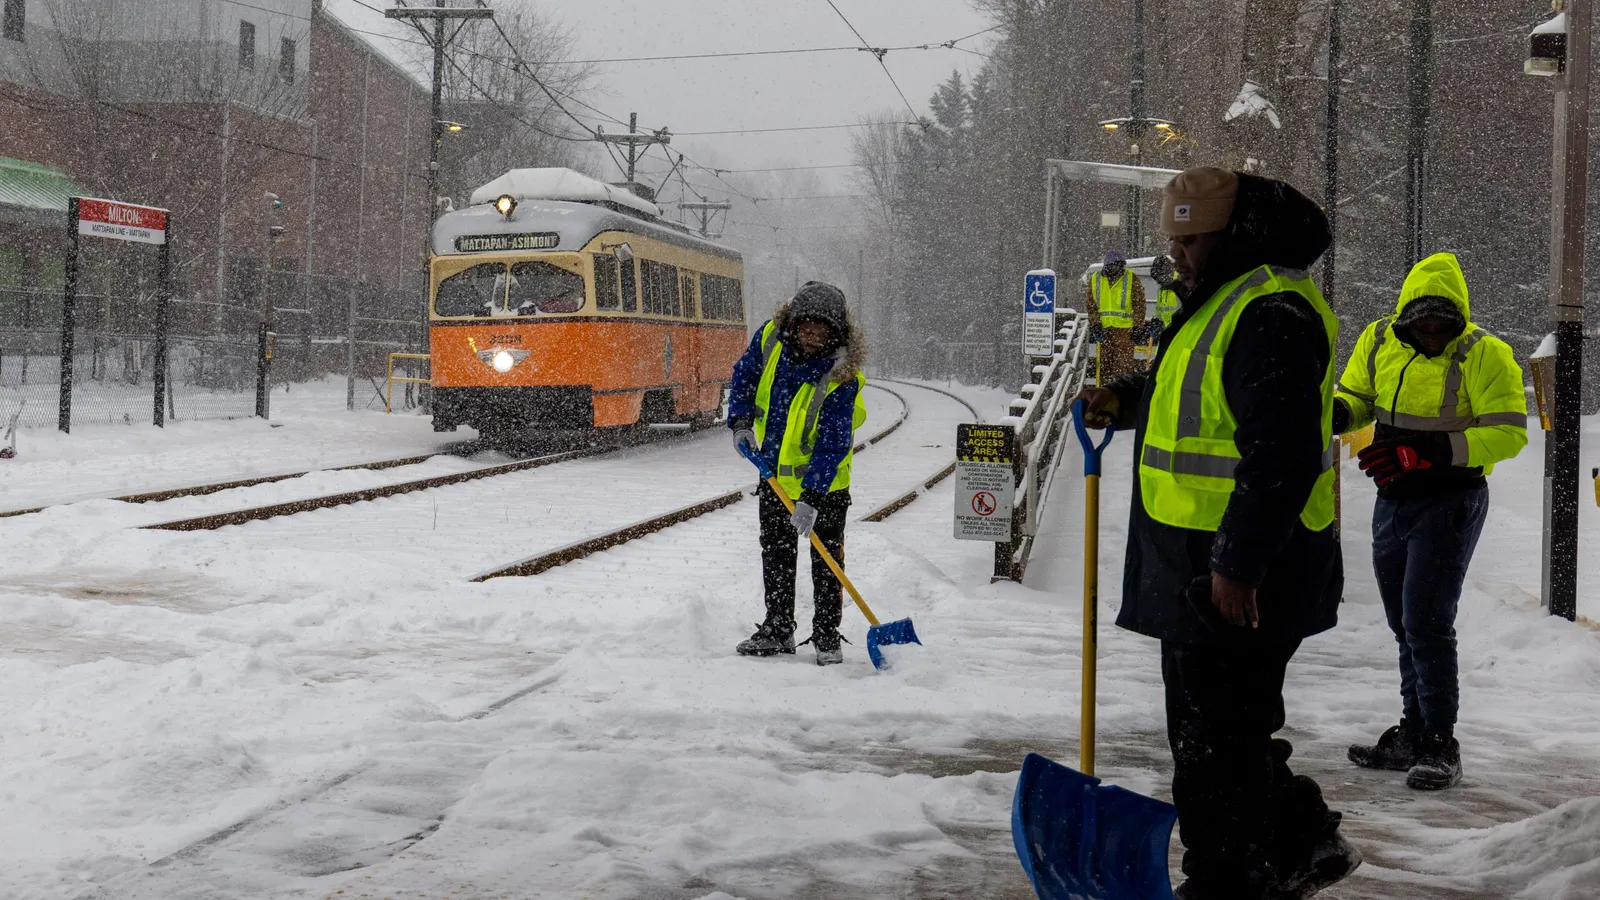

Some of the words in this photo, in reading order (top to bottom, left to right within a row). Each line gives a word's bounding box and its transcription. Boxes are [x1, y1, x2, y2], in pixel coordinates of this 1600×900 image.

[108, 206, 140, 224] MILTON
[92, 224, 115, 234] MATTAPAN
[115, 226, 126, 236] LINE
[129, 229, 151, 239] MATTAPAN
[968, 430, 1005, 438] LIMITED
[968, 438, 1005, 447] ACCESS
[973, 448, 998, 456] AREA
